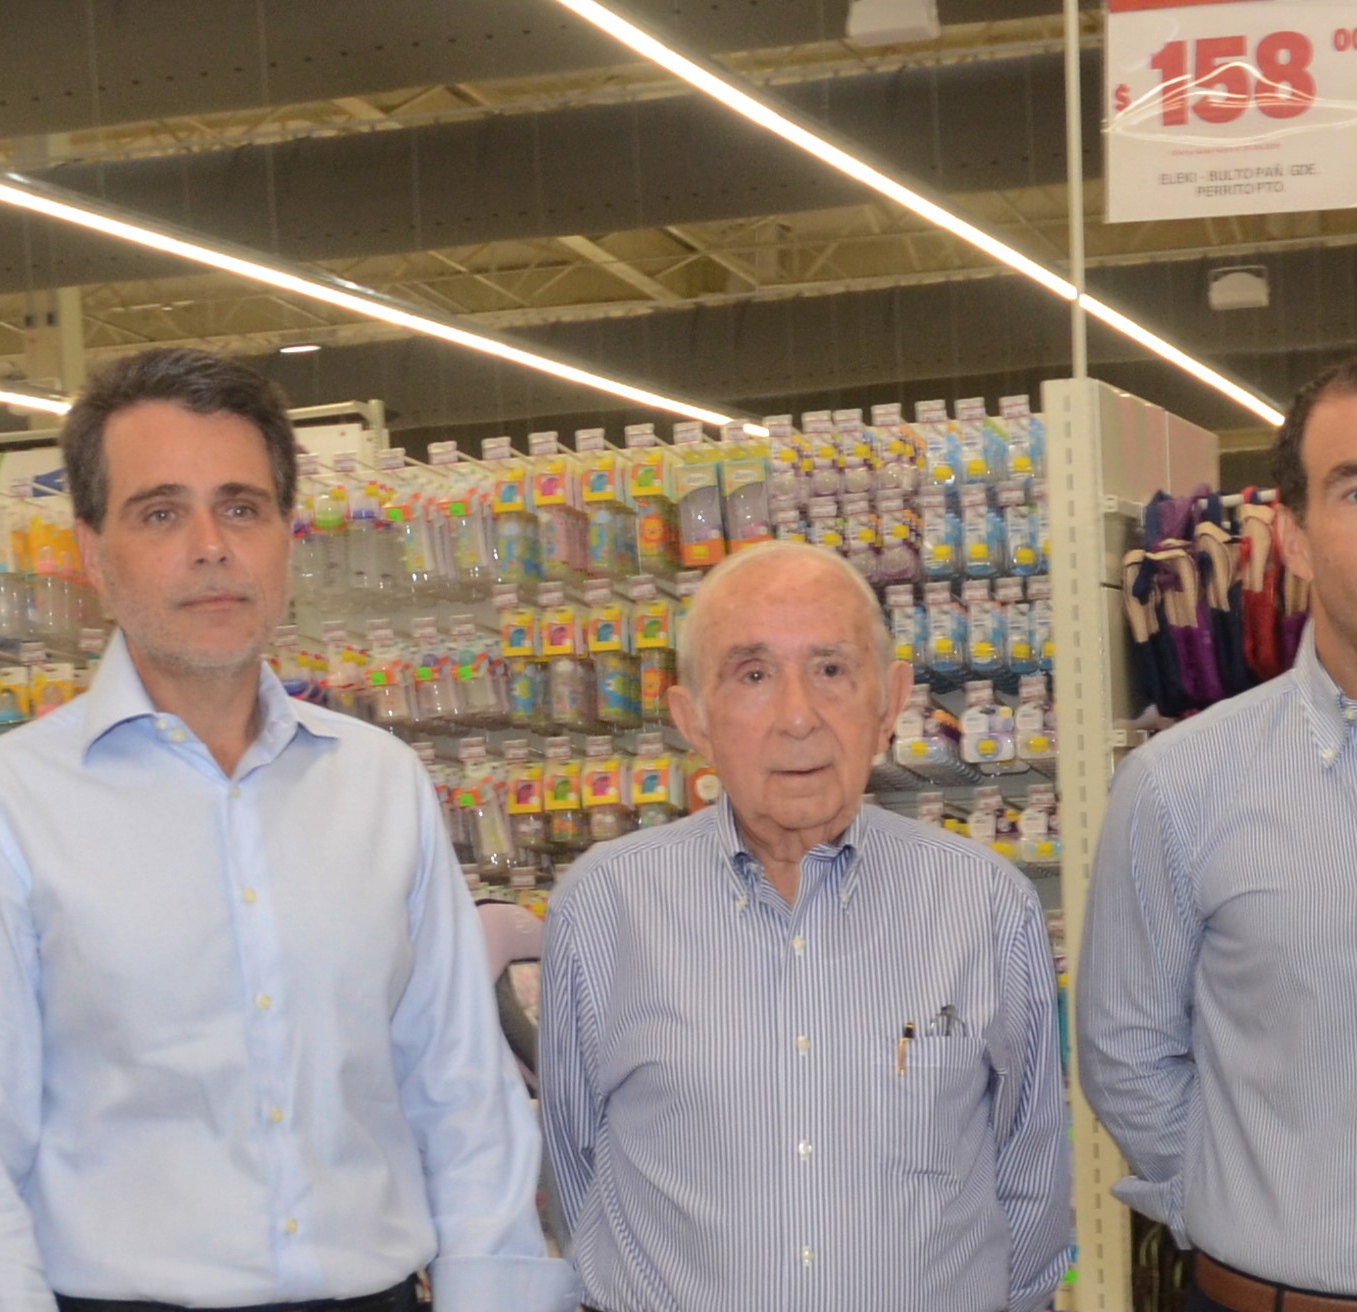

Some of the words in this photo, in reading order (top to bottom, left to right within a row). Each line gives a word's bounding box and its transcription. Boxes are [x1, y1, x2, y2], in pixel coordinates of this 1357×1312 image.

[1113, 83, 1132, 112] $
[1150, 30, 1316, 126] 158
[1196, 183, 1255, 197] PERRITO
